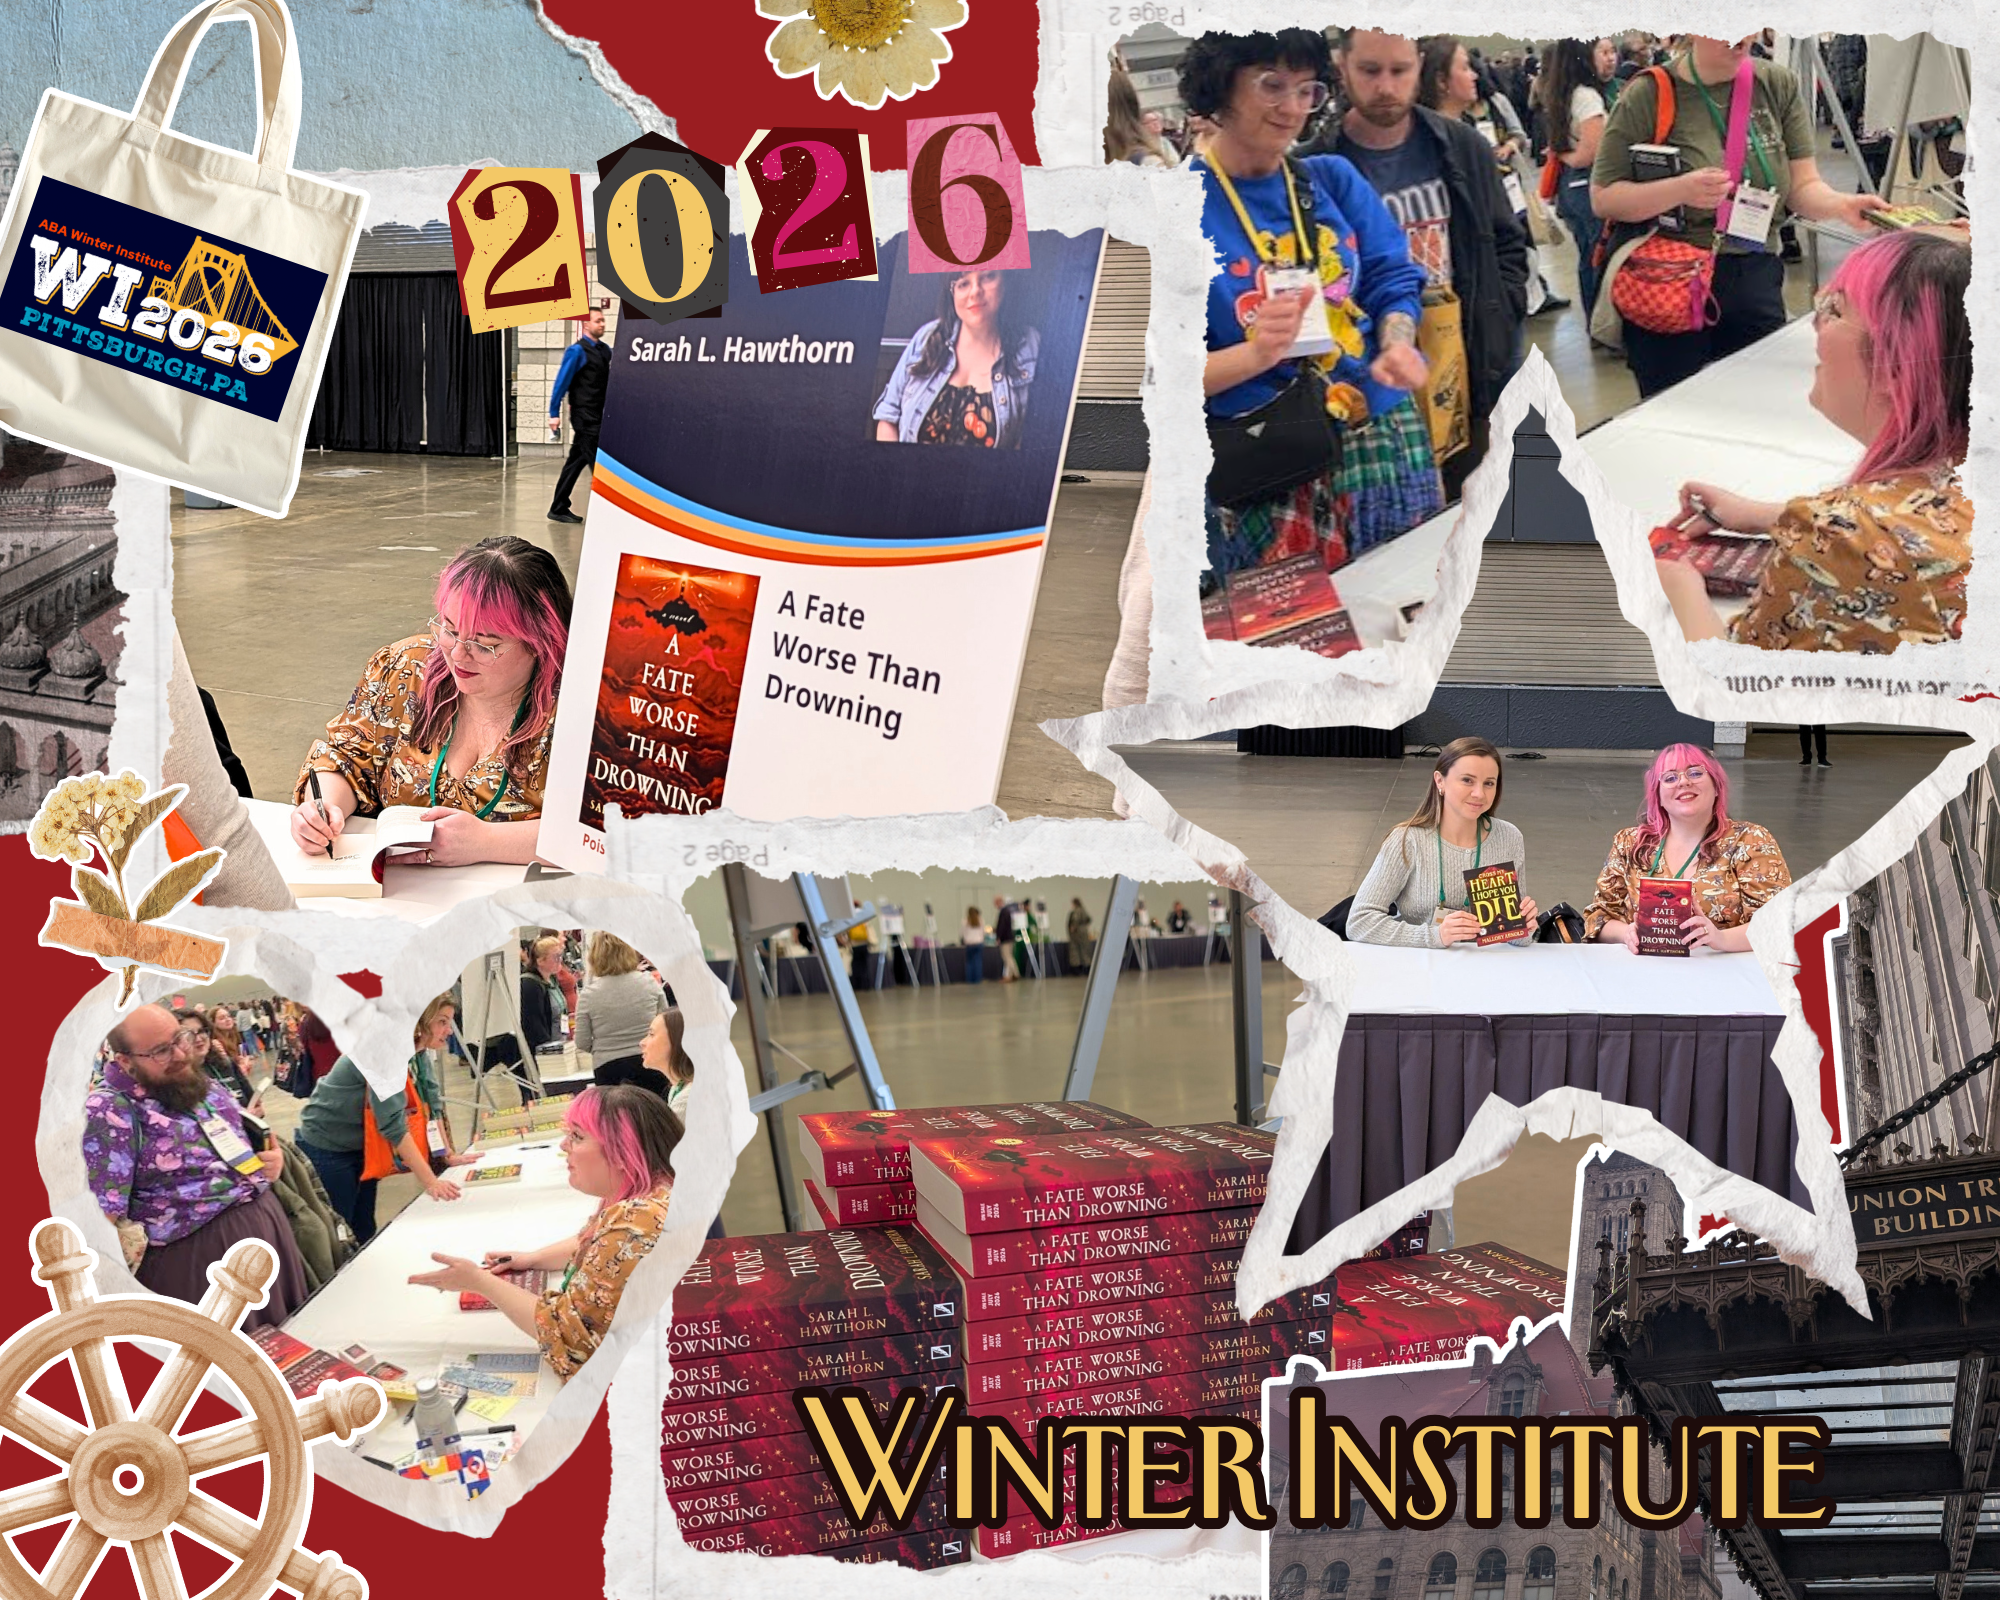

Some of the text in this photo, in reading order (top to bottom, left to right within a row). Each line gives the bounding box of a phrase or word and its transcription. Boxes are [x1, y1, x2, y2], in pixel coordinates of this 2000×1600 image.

[38, 218, 172, 273] ABA Winter Institute
[629, 335, 855, 365] Sarah L. Hawthorn
[777, 590, 866, 631] A Fate
[664, 633, 680, 656] A
[772, 630, 943, 695] Worse Than
[641, 662, 695, 697] FATE
[628, 695, 700, 737] WORSE
[764, 672, 904, 741] Drowning
[627, 732, 689, 773] THAN
[1469, 871, 1514, 893] HEART
[1471, 884, 1516, 901] I HOPE YOU
[1473, 893, 1522, 927] DIE
[1650, 917, 1679, 926] WORSE
[1654, 907, 1675, 915] FATE
[1641, 936, 1682, 946] DROWNIN
[1651, 927, 1676, 935] THAN
[884, 1155, 890, 1163] A
[1215, 1173, 1257, 1189] SARAH
[1957, 1177, 2000, 1199] TR
[1034, 1182, 1146, 1205] A FATE WORSE
[1023, 1197, 1169, 1224] THAN DROWNING
[1040, 1225, 1150, 1248] A FATE WORSE
[783, 1245, 820, 1278] THAN
[827, 1230, 886, 1290] DROWNING
[1029, 1239, 1172, 1268] THAN DROWNING
[732, 1248, 762, 1286] WORSE
[1034, 1268, 1143, 1292] A FATE WORSE
[1392, 1272, 1468, 1307] WORSE
[1431, 1270, 1502, 1299] THAN
[1440, 1253, 1566, 1309] DROWNING
[1023, 1281, 1165, 1310] THAN DROWNING
[1349, 1295, 1377, 1304] A
[1365, 1282, 1430, 1308] FATE
[807, 1305, 874, 1324] SARAH L.
[1034, 1308, 1143, 1333] A FATE WORSE
[799, 1317, 887, 1338] HAWTHORN
[1024, 1321, 1165, 1351] THAN DROWNING
[1201, 1345, 1271, 1364] HAWTHORN
[1209, 1335, 1262, 1351] SARAH L.
[1390, 1340, 1431, 1357] A FATE
[806, 1349, 872, 1368] SARAH L.
[1034, 1348, 1142, 1374] A FATE WORSE
[798, 1360, 885, 1382] HAWTHORN
[1023, 1360, 1164, 1392] THAN DROWNING
[1209, 1372, 1261, 1388] SARAH L.
[1035, 1388, 1142, 1414] A FATE WORSE
[664, 1407, 730, 1428] WORSE
[661, 1420, 757, 1446] ROWNING
[671, 1450, 735, 1472] WORSE
[677, 1492, 740, 1513] WORSE
[687, 1532, 746, 1552] WORSE
[1033, 1526, 1077, 1545] THAN
